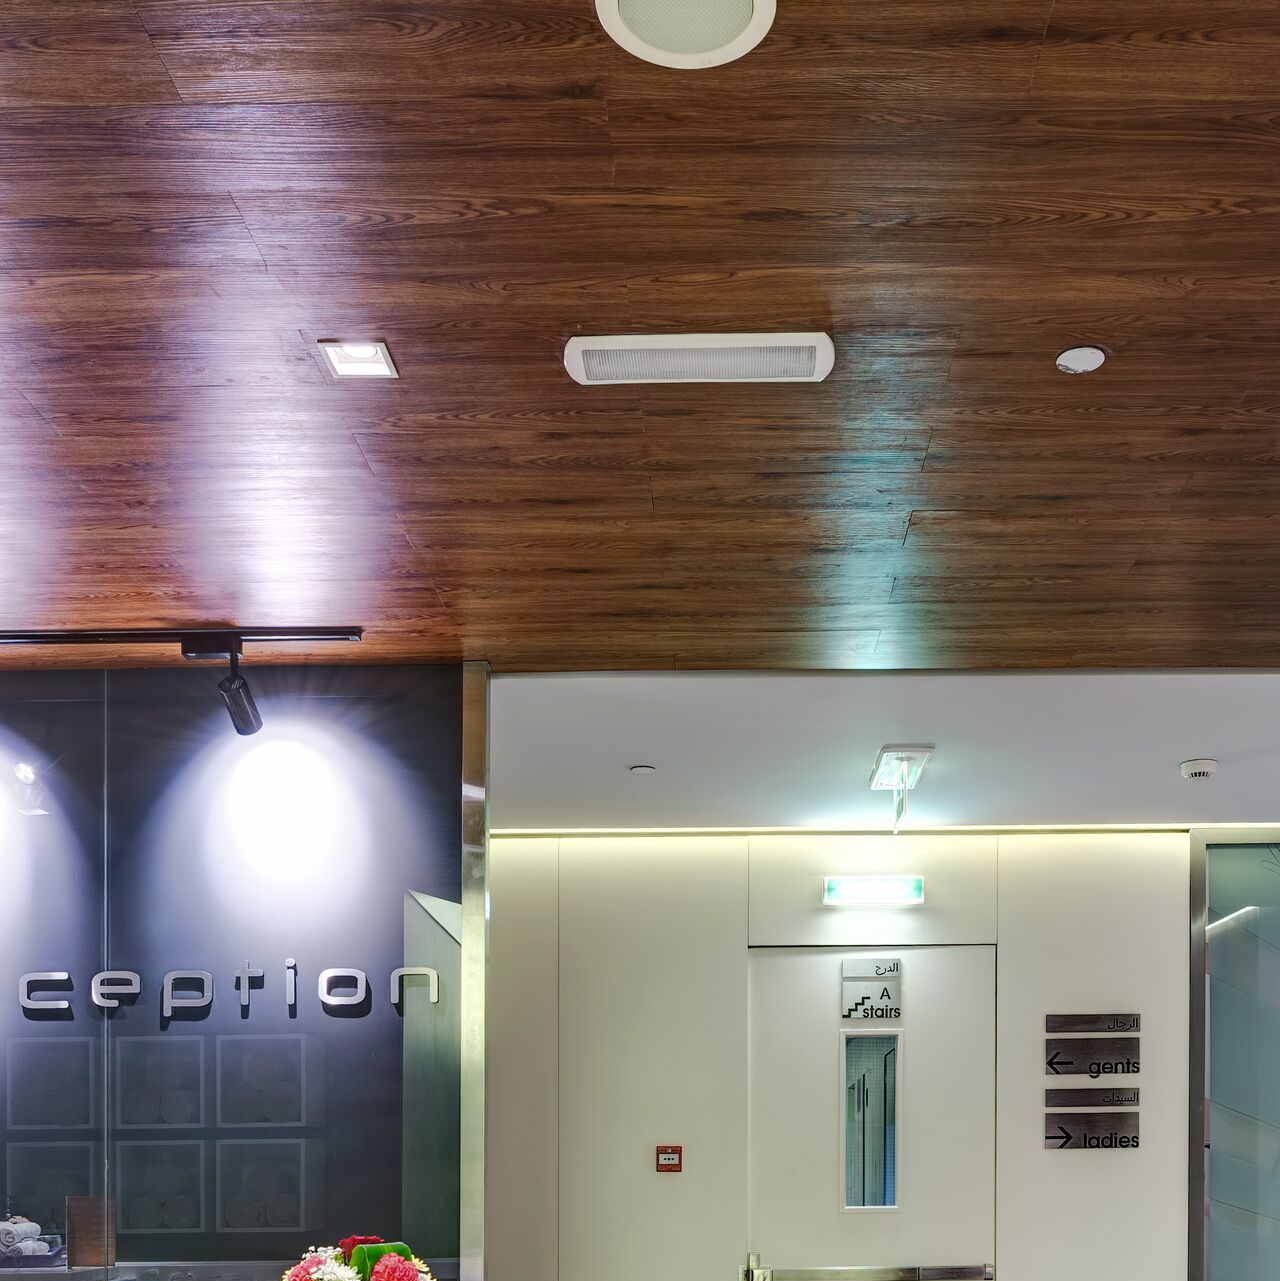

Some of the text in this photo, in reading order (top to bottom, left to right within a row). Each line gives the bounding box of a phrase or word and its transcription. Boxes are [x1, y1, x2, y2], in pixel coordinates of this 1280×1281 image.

[875, 962, 898, 976] الدرج
[880, 987, 891, 1000] A
[863, 1005, 901, 1018] stairs
[1107, 1018, 1139, 1031] الرجال
[1088, 1058, 1140, 1079] gents
[1102, 1091, 1139, 1104] السيدات
[1083, 1132, 1140, 1149] ladies
